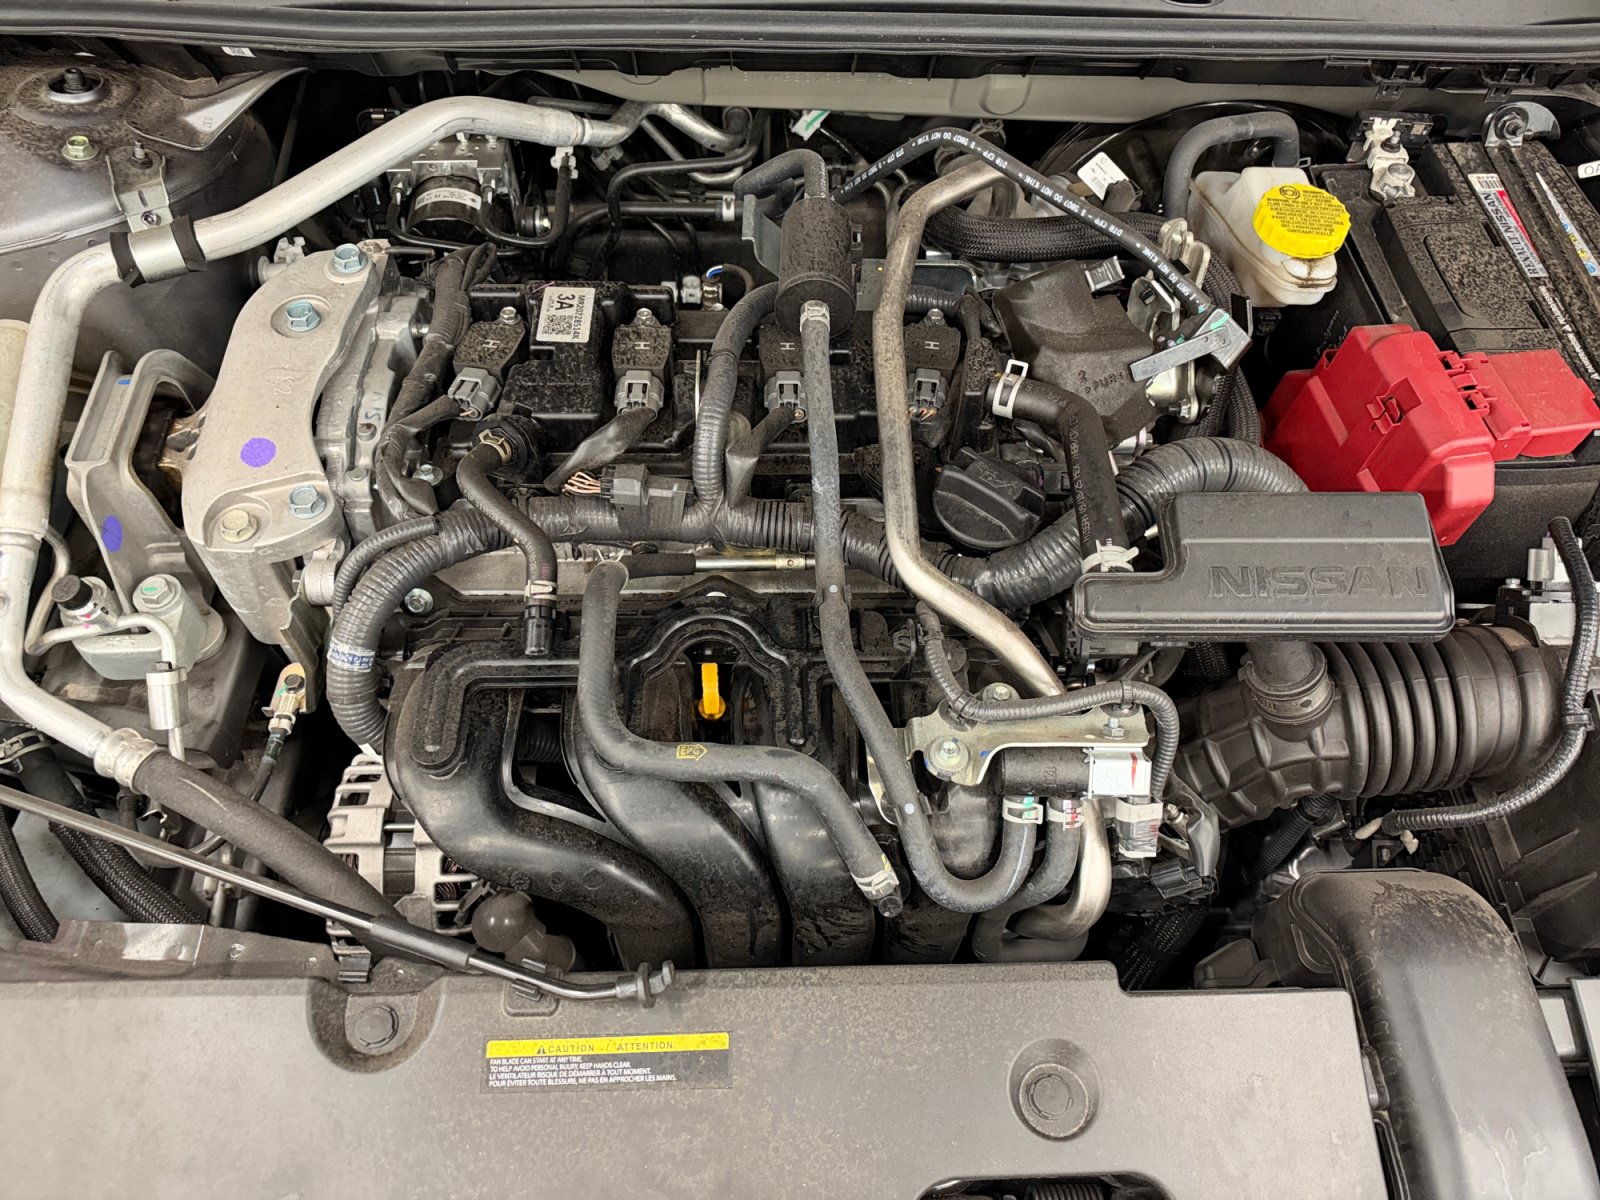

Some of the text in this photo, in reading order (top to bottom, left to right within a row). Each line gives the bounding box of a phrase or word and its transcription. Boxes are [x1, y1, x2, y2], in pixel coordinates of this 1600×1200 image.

[931, 132, 941, 140] NOT
[1040, 184, 1053, 197] NOT
[1482, 192, 1514, 234] NISSAN
[1508, 235, 1539, 275] RENAULT
[1157, 262, 1170, 275] NOT
[555, 294, 575, 310] 3A
[1209, 565, 1429, 598] NISSAN
[548, 1044, 595, 1053] CAUTION
[616, 1041, 673, 1051] ATTENTION
[497, 1072, 536, 1080] VENTILATEUR
[569, 1069, 600, 1077] DÉMARRER
[507, 1079, 526, 1087] ÉVITER
[610, 1075, 644, 1083] APPROCHER
